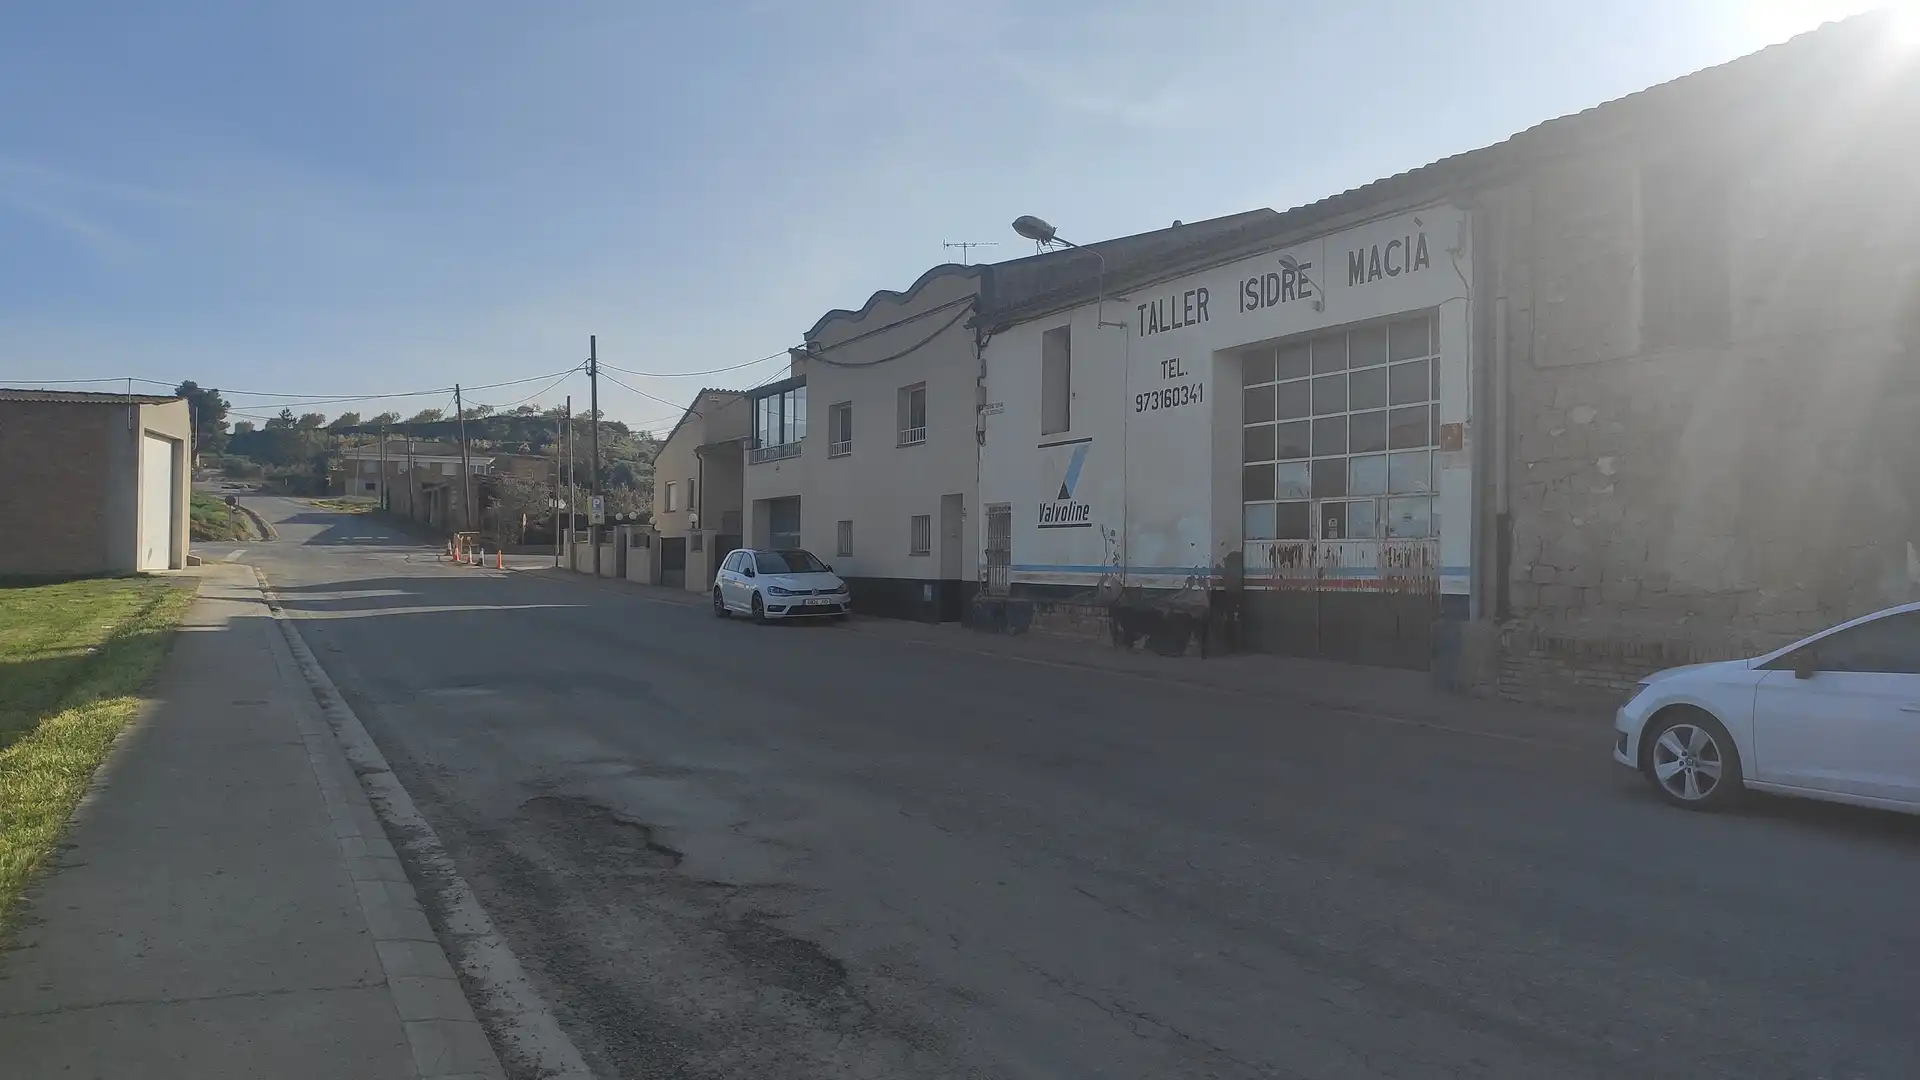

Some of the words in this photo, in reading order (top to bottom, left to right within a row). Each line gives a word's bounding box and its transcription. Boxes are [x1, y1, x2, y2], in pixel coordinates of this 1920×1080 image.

[1137, 287, 1210, 337] TALLER
[1239, 261, 1312, 314] ISIDRE
[1348, 216, 1430, 287] MACIÀ
[1161, 357, 1188, 380] TEL.
[1135, 382, 1203, 413] 973160341
[592, 498, 600, 508] P
[1039, 501, 1090, 523] Valvoline
